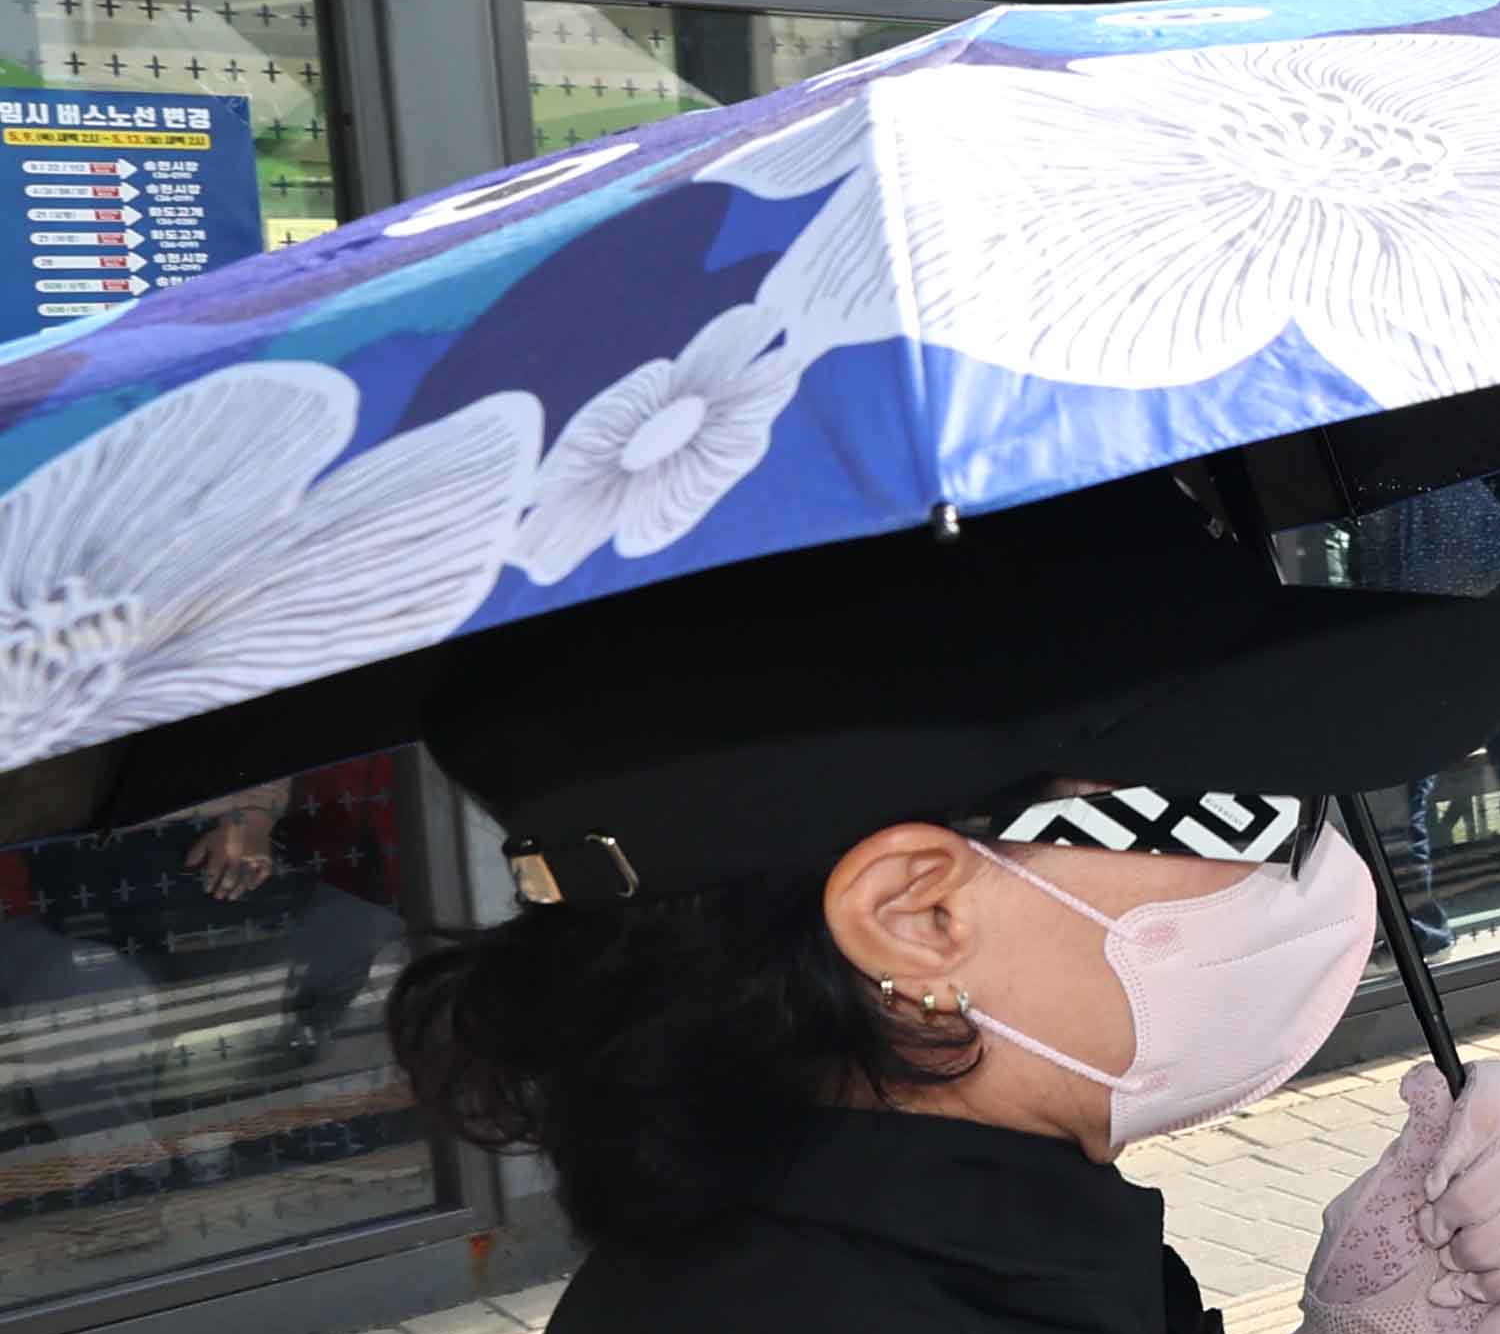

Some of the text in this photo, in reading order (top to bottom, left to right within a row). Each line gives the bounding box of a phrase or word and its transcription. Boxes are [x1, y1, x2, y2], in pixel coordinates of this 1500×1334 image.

[0, 101, 211, 129] 임시 버스노선 변경
